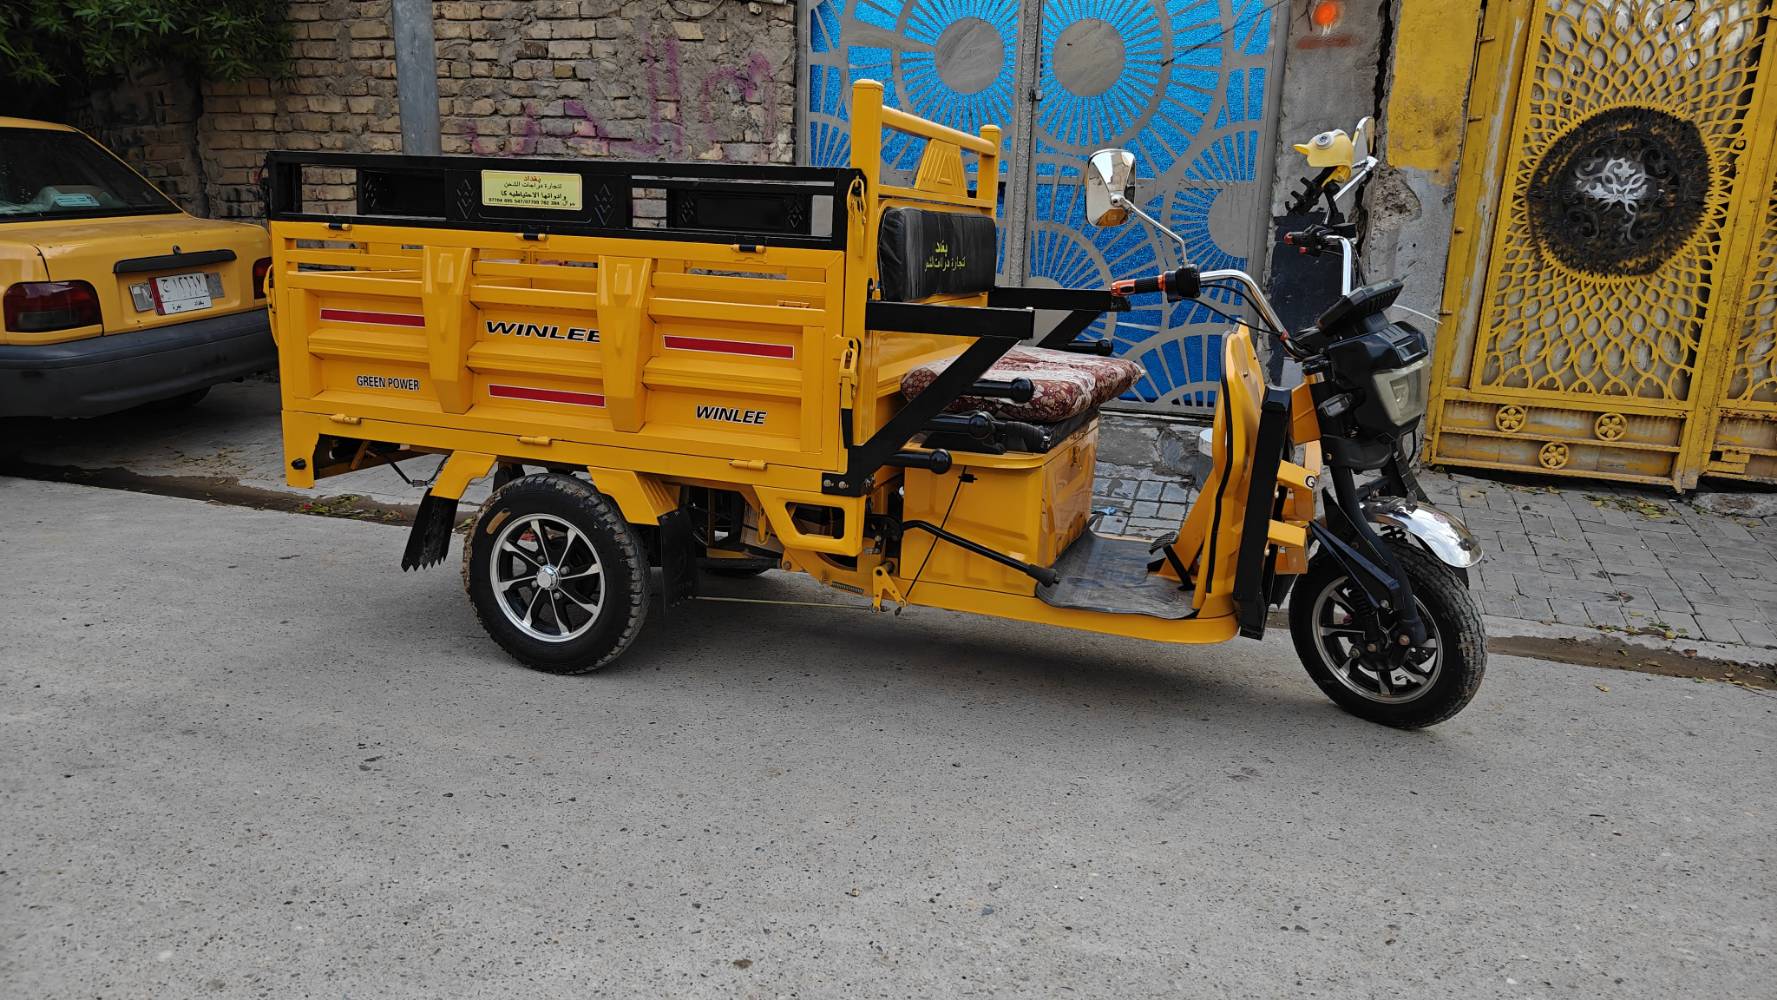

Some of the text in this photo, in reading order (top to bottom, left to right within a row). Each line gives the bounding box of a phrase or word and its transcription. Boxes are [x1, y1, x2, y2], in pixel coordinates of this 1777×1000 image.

[486, 320, 600, 342] WINLEE
[356, 375, 420, 391] GREEN POWER
[696, 404, 767, 425] WINLEE
